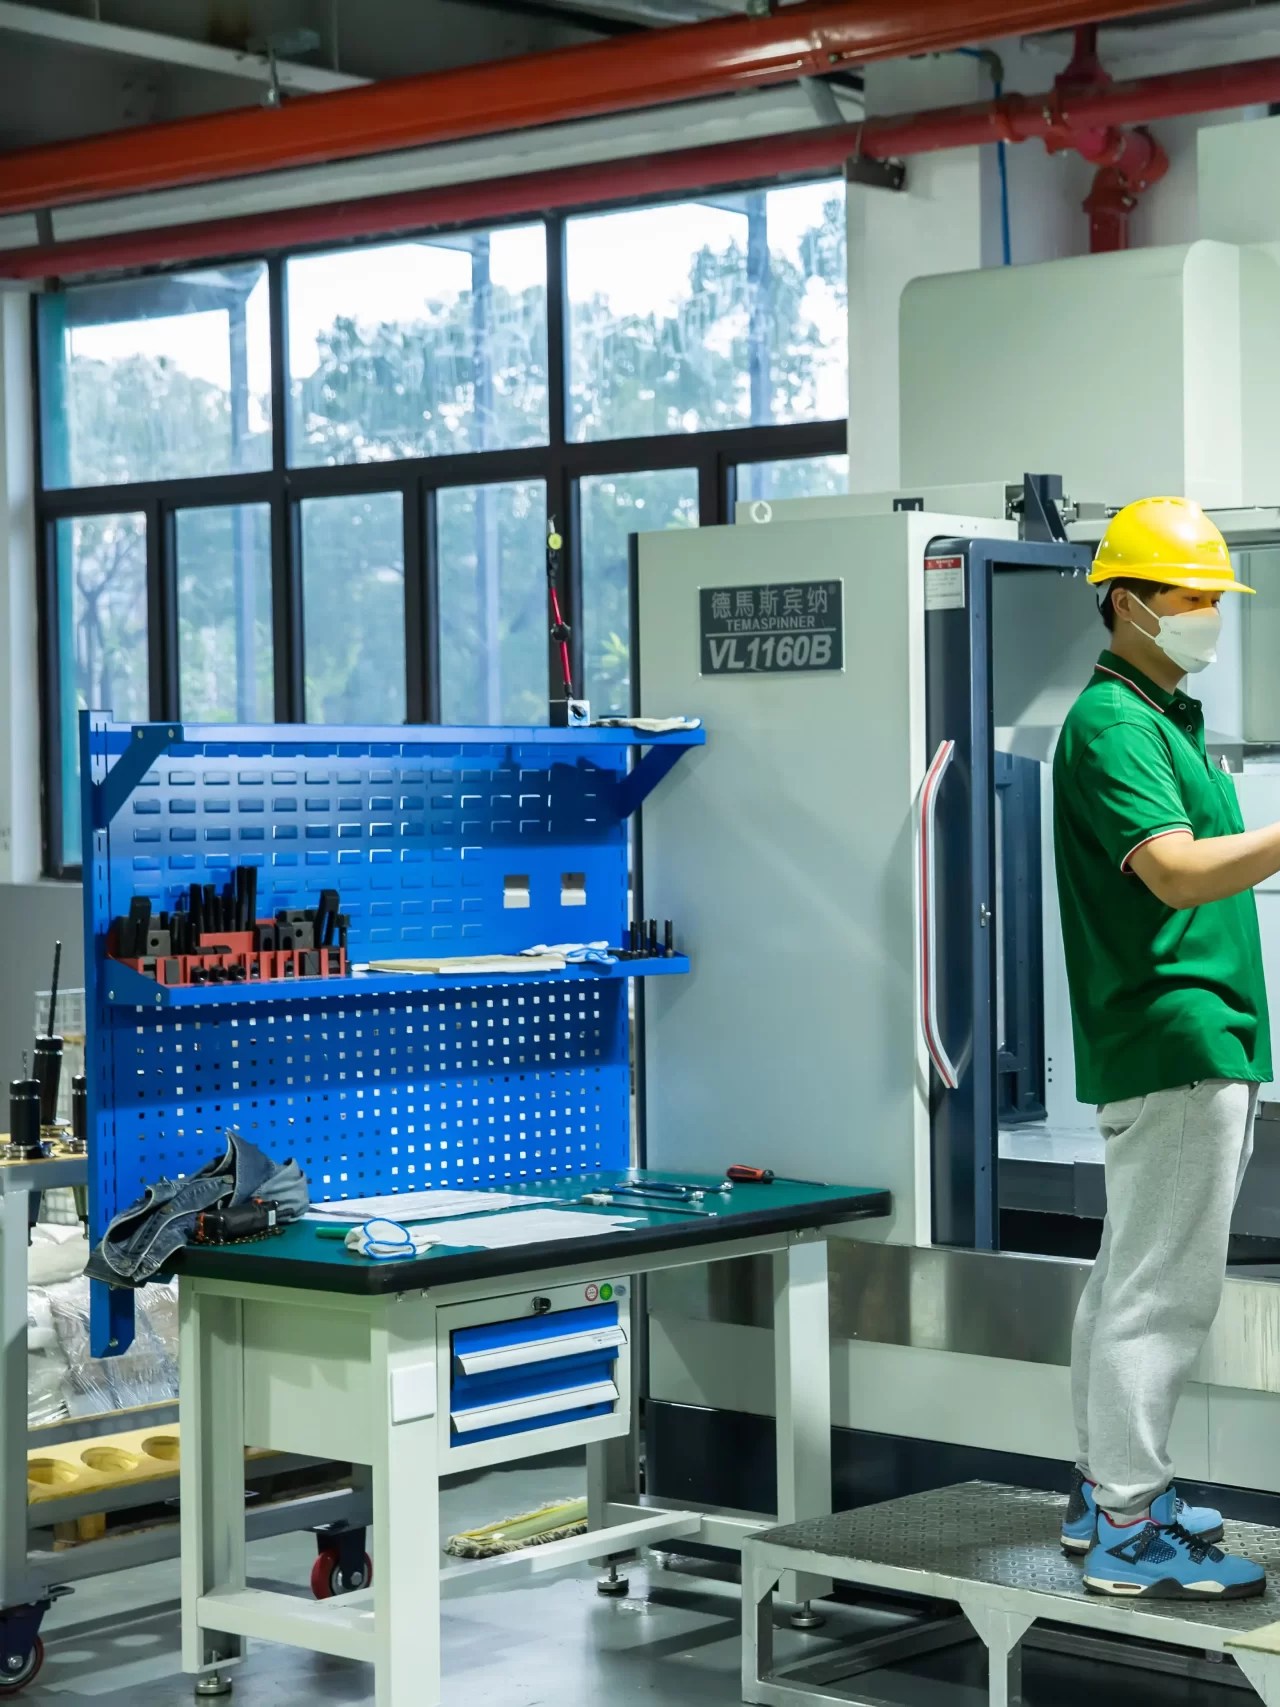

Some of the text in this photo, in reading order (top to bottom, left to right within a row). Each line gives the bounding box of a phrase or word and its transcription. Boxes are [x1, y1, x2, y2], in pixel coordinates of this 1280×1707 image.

[711, 585, 828, 619] 德馬斯宾纳
[726, 615, 815, 631] TEMASPINNER
[709, 634, 832, 670] VL1160B
